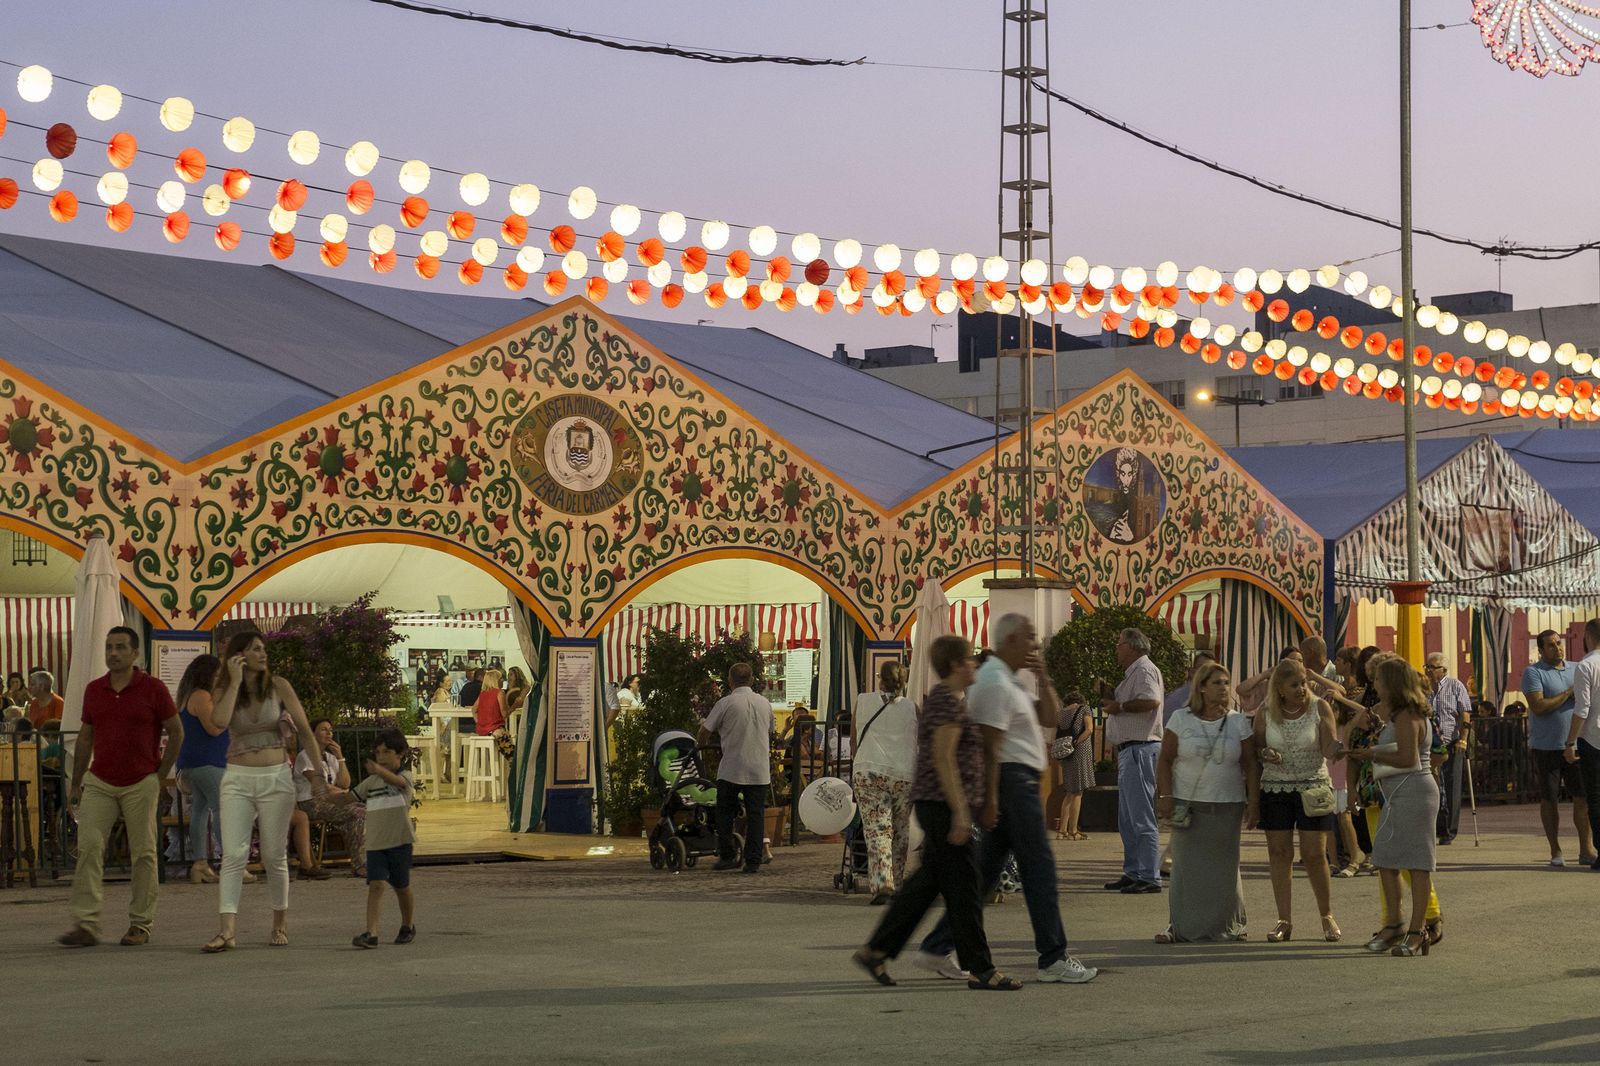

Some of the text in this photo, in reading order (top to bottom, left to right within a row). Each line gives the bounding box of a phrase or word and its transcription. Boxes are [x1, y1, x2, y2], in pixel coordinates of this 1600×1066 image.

[536, 396, 619, 436] CASETA MUNICIPAL
[528, 472, 565, 510] FERIA
[566, 491, 582, 513] DEL
[583, 480, 625, 514] CARMEN
